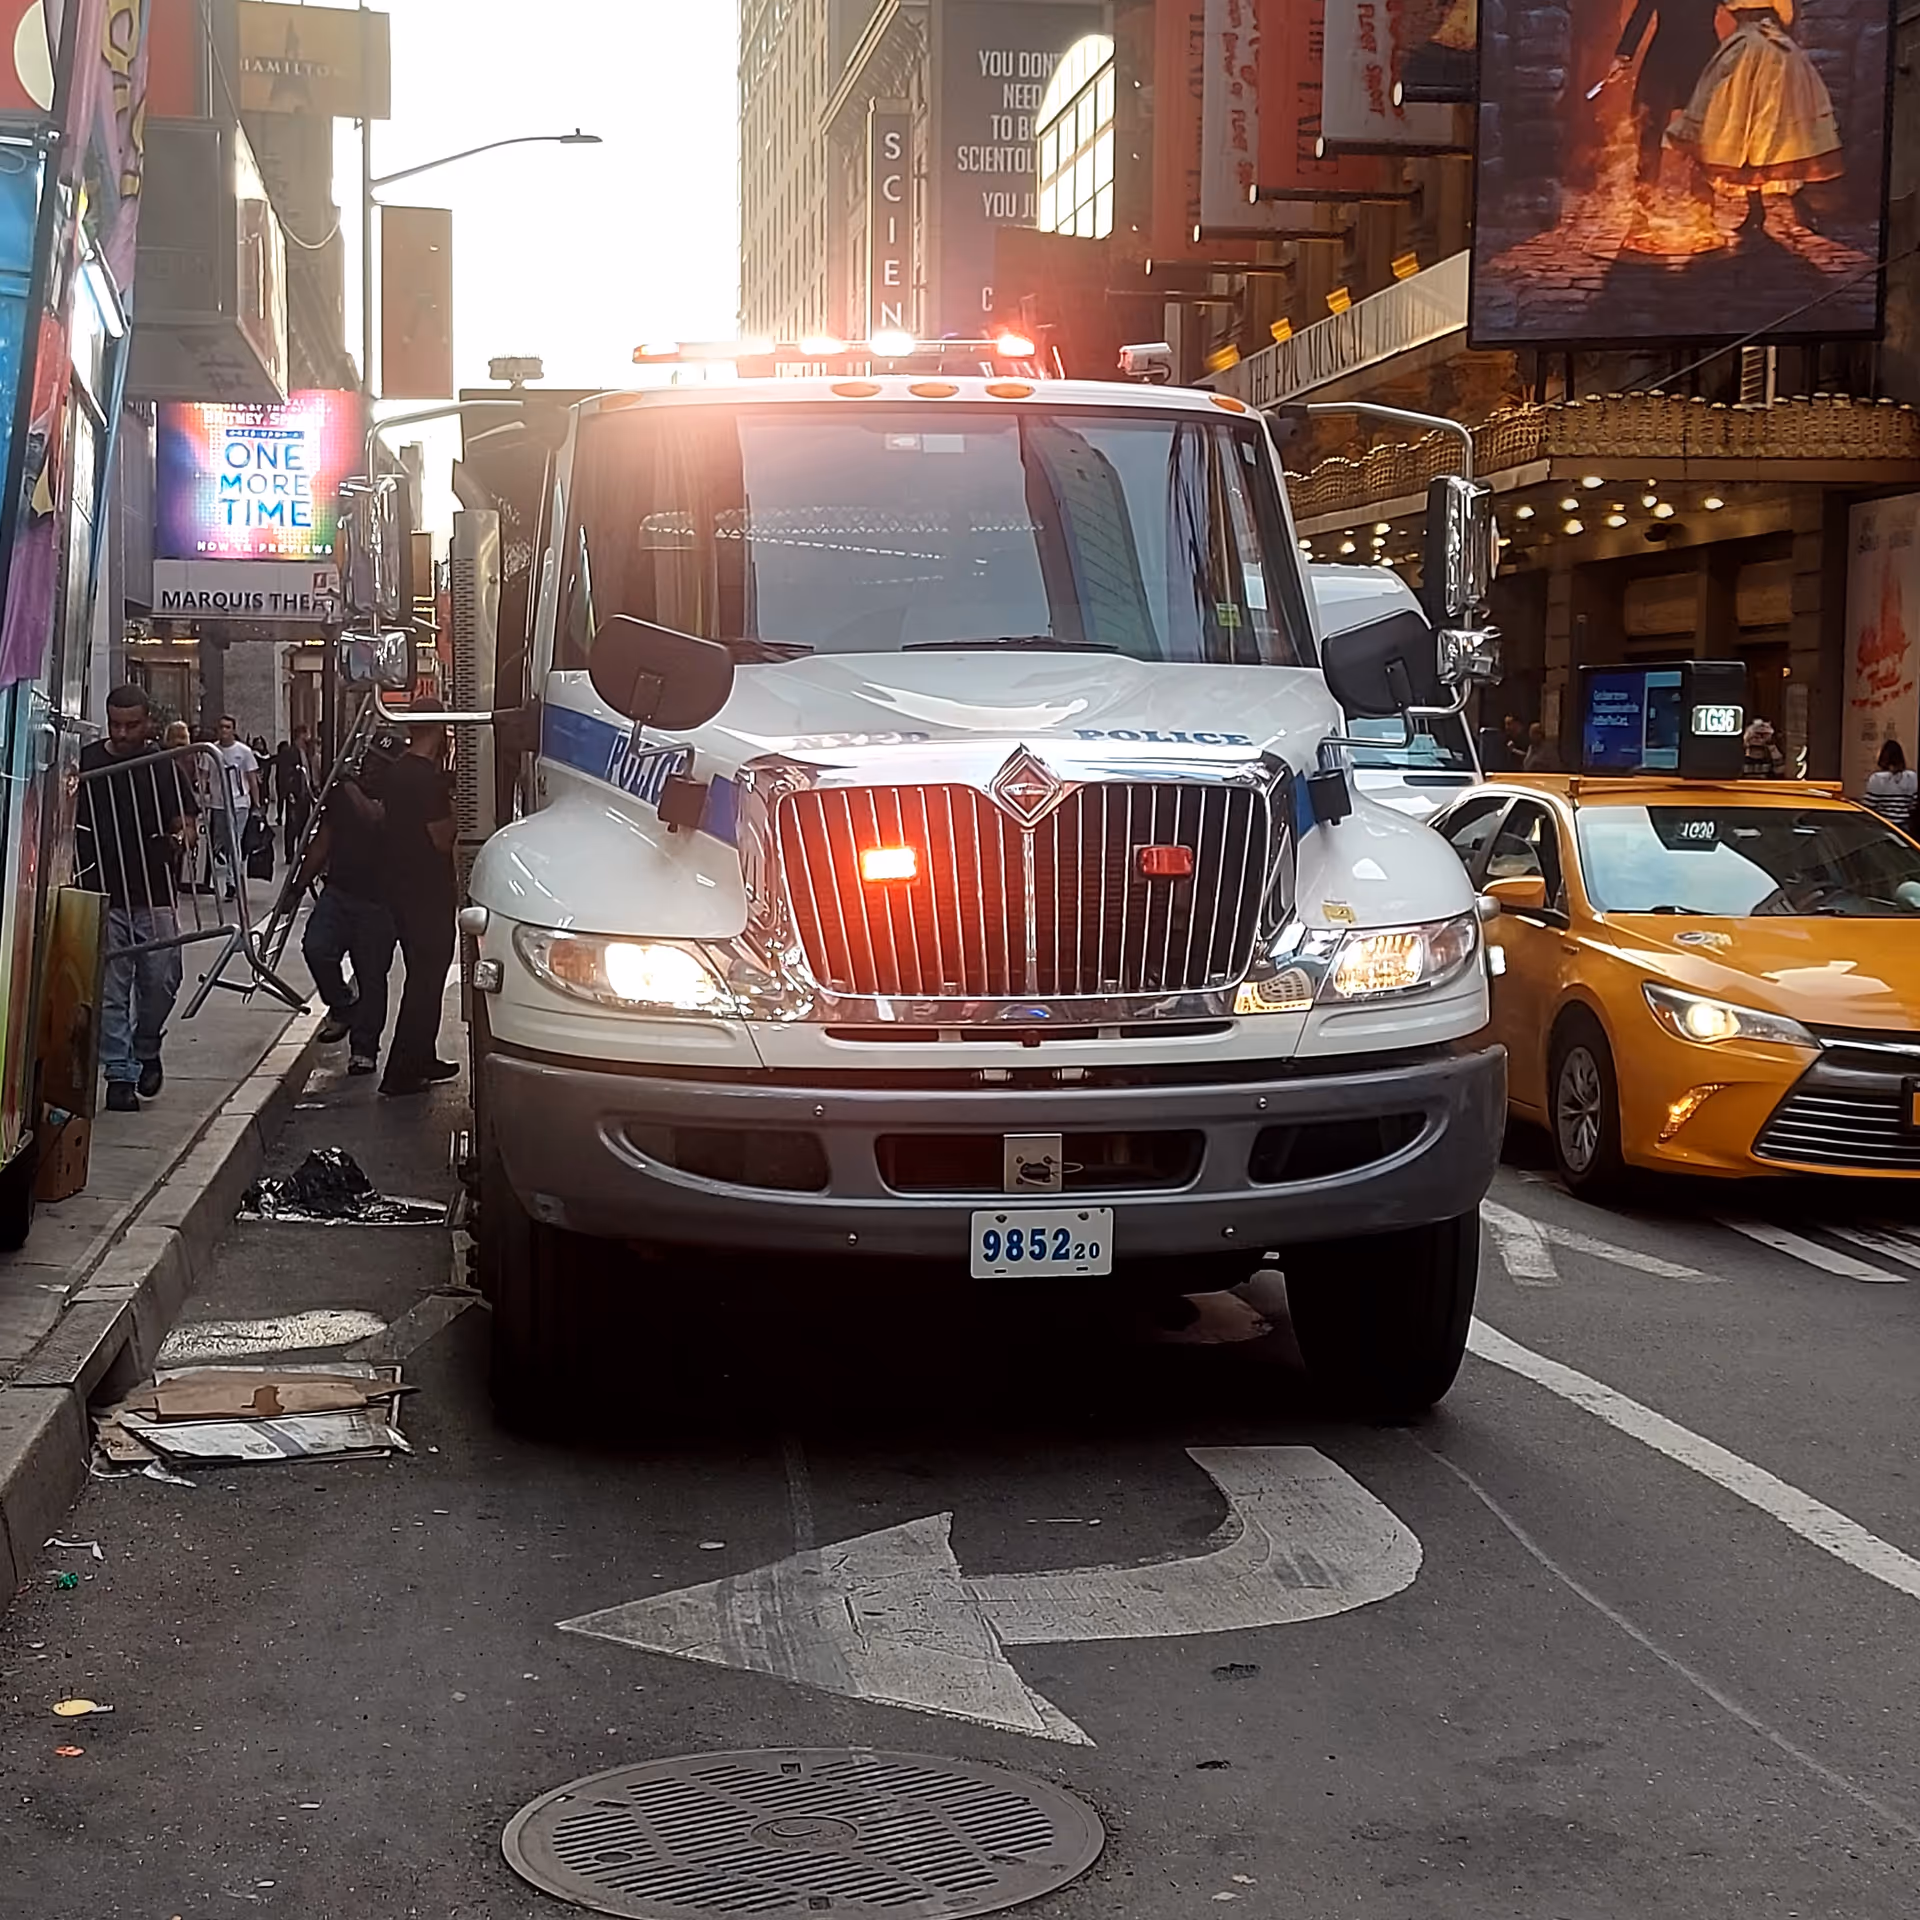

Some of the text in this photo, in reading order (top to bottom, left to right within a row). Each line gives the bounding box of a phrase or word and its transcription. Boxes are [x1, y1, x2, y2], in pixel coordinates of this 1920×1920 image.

[239, 58, 342, 78] HAMILTO
[978, 50, 1013, 77] YOU
[1003, 83, 1042, 110] NEED
[990, 115, 1013, 141] TO
[982, 192, 1017, 218] YOU
[1250, 351, 1272, 408] THE
[1275, 333, 1301, 398] EPIC
[225, 442, 305, 470] ONE
[219, 473, 310, 496] MORE
[219, 498, 312, 527] TIME
[162, 590, 264, 612] MARQUIS
[1072, 729, 1254, 747] POLICE
[982, 1227, 1101, 1263] 9852 20
